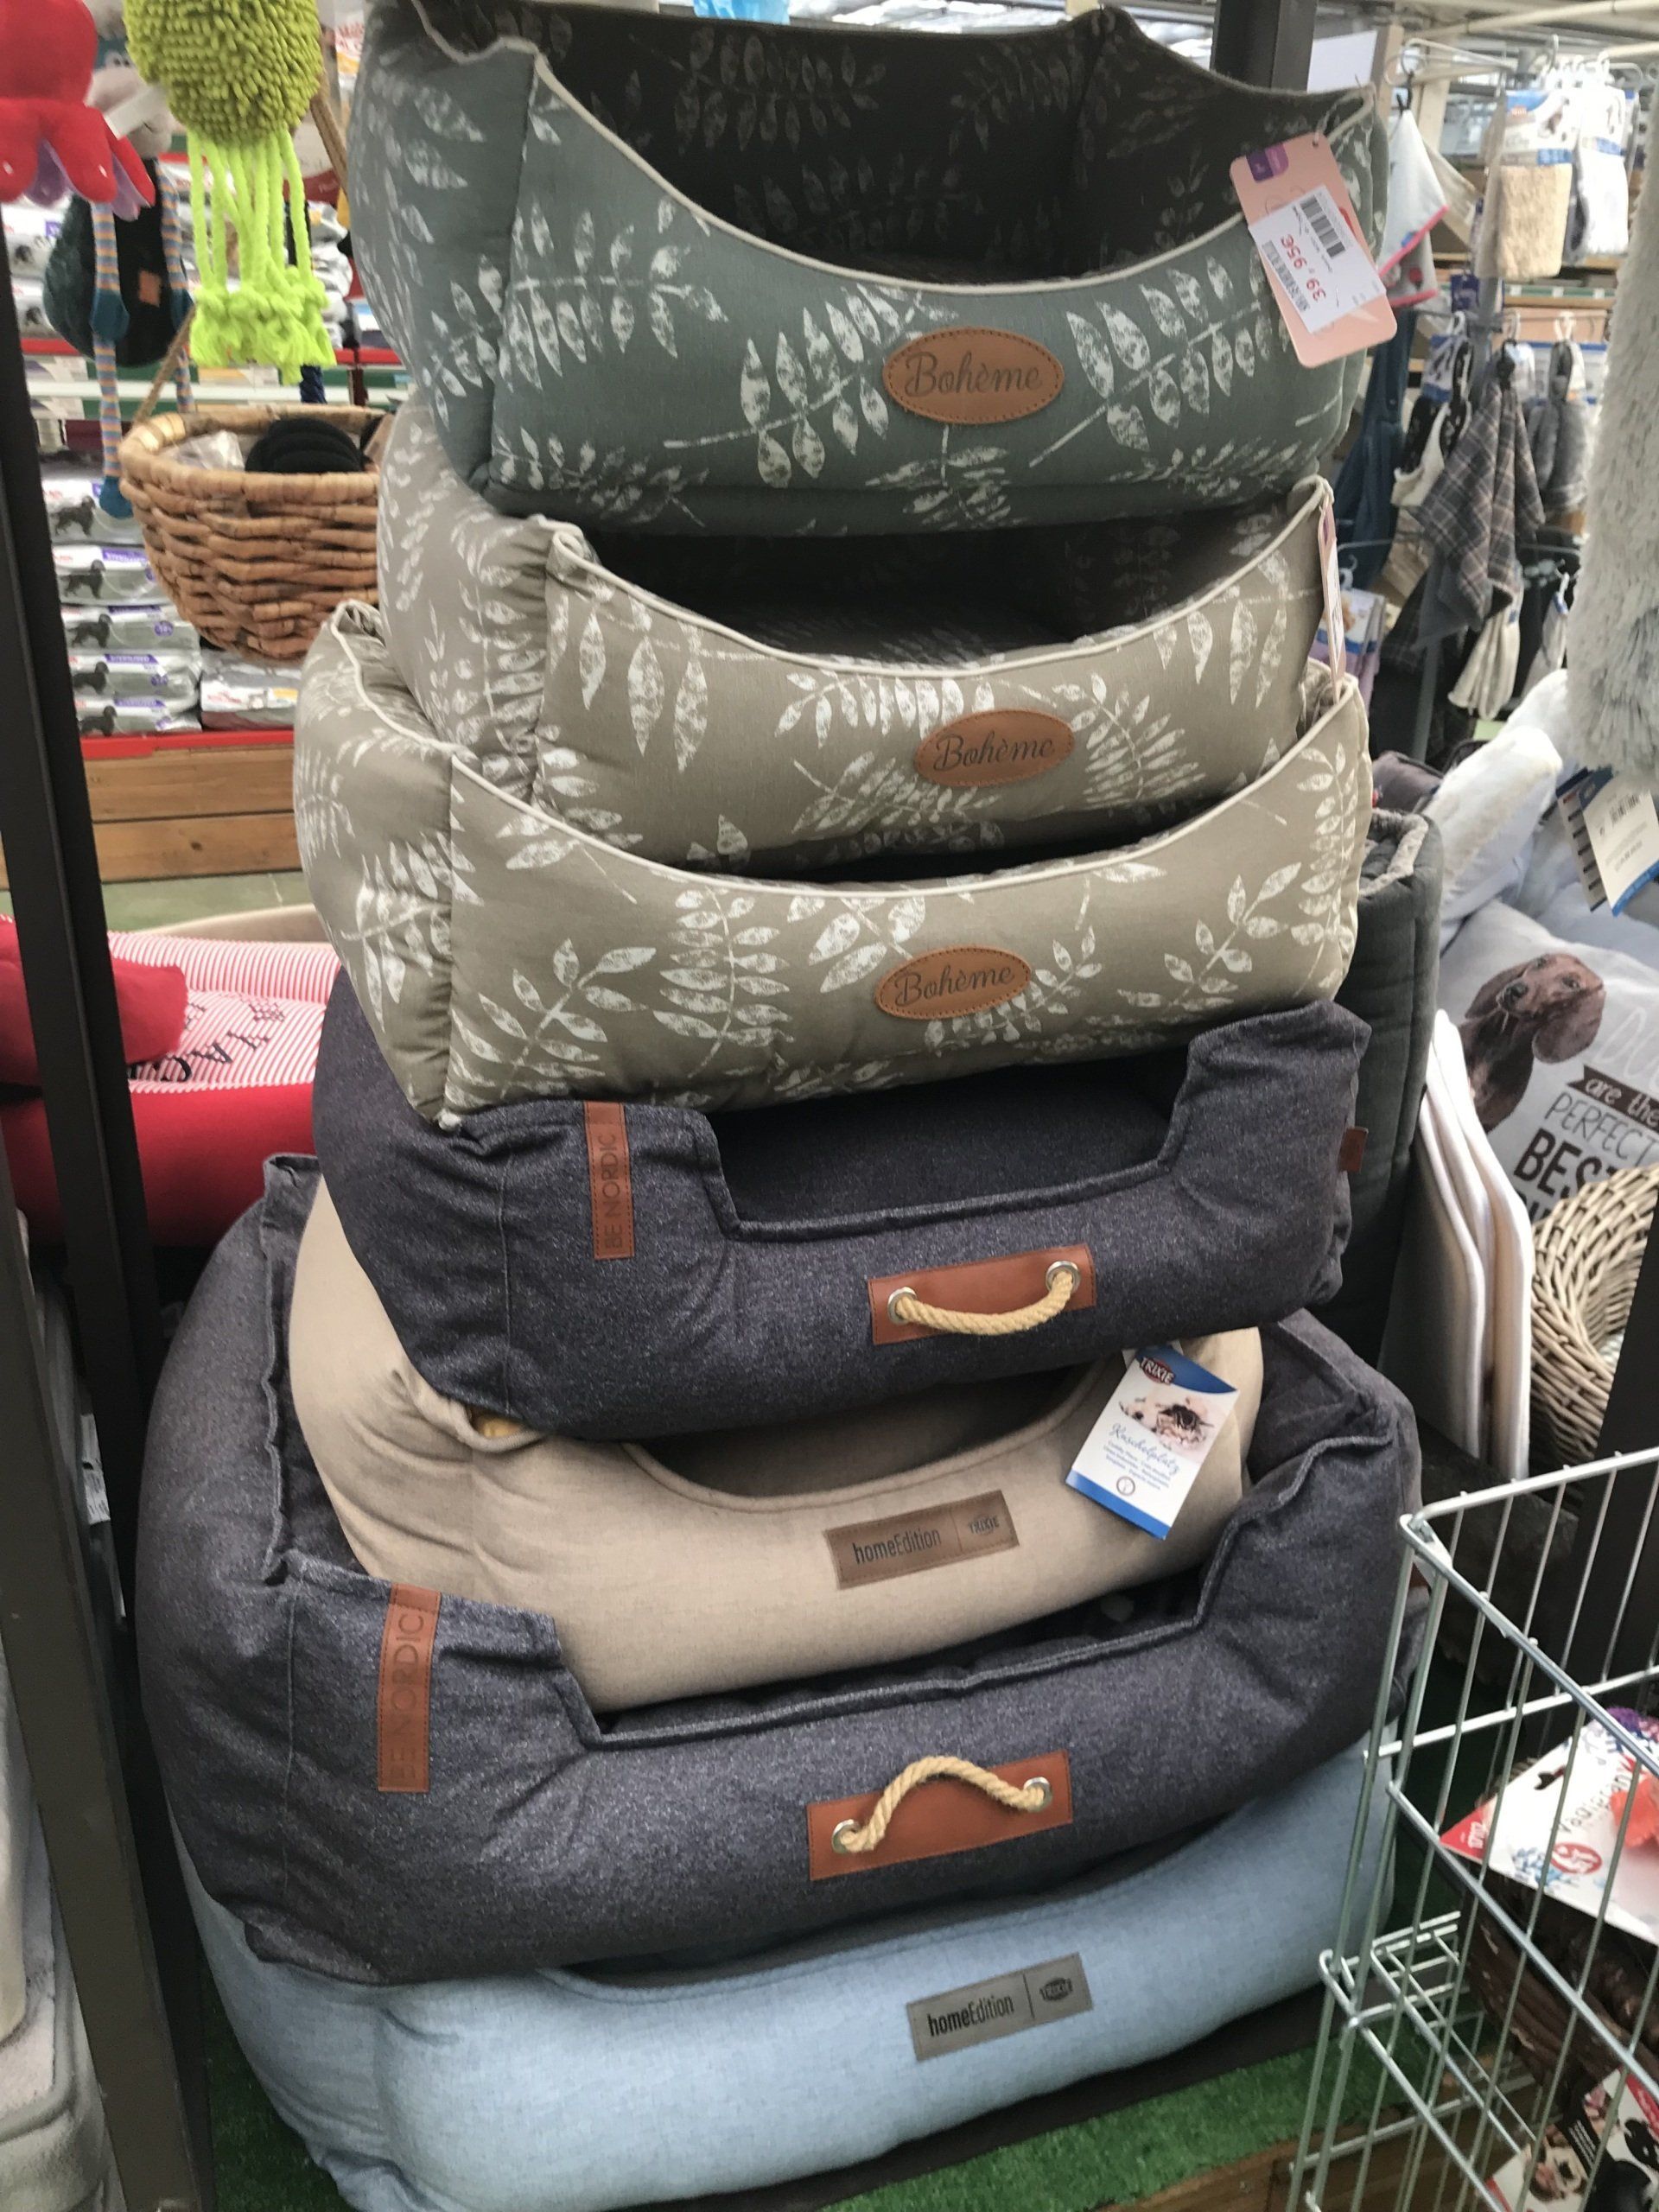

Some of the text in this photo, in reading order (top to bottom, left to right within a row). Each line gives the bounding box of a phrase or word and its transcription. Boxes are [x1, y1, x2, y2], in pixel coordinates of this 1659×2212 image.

[904, 349, 1043, 397] Bohème
[933, 730, 1056, 772] Bohème
[894, 963, 1015, 1007] Bohème
[1585, 1077, 1622, 1105] are
[597, 1133, 622, 1218] NORDIC
[1513, 1127, 1618, 1198] BES
[1140, 1356, 1176, 1385] TRIXIE
[852, 1527, 942, 1565] homeEdition
[926, 1993, 1015, 2037] homeEdition
